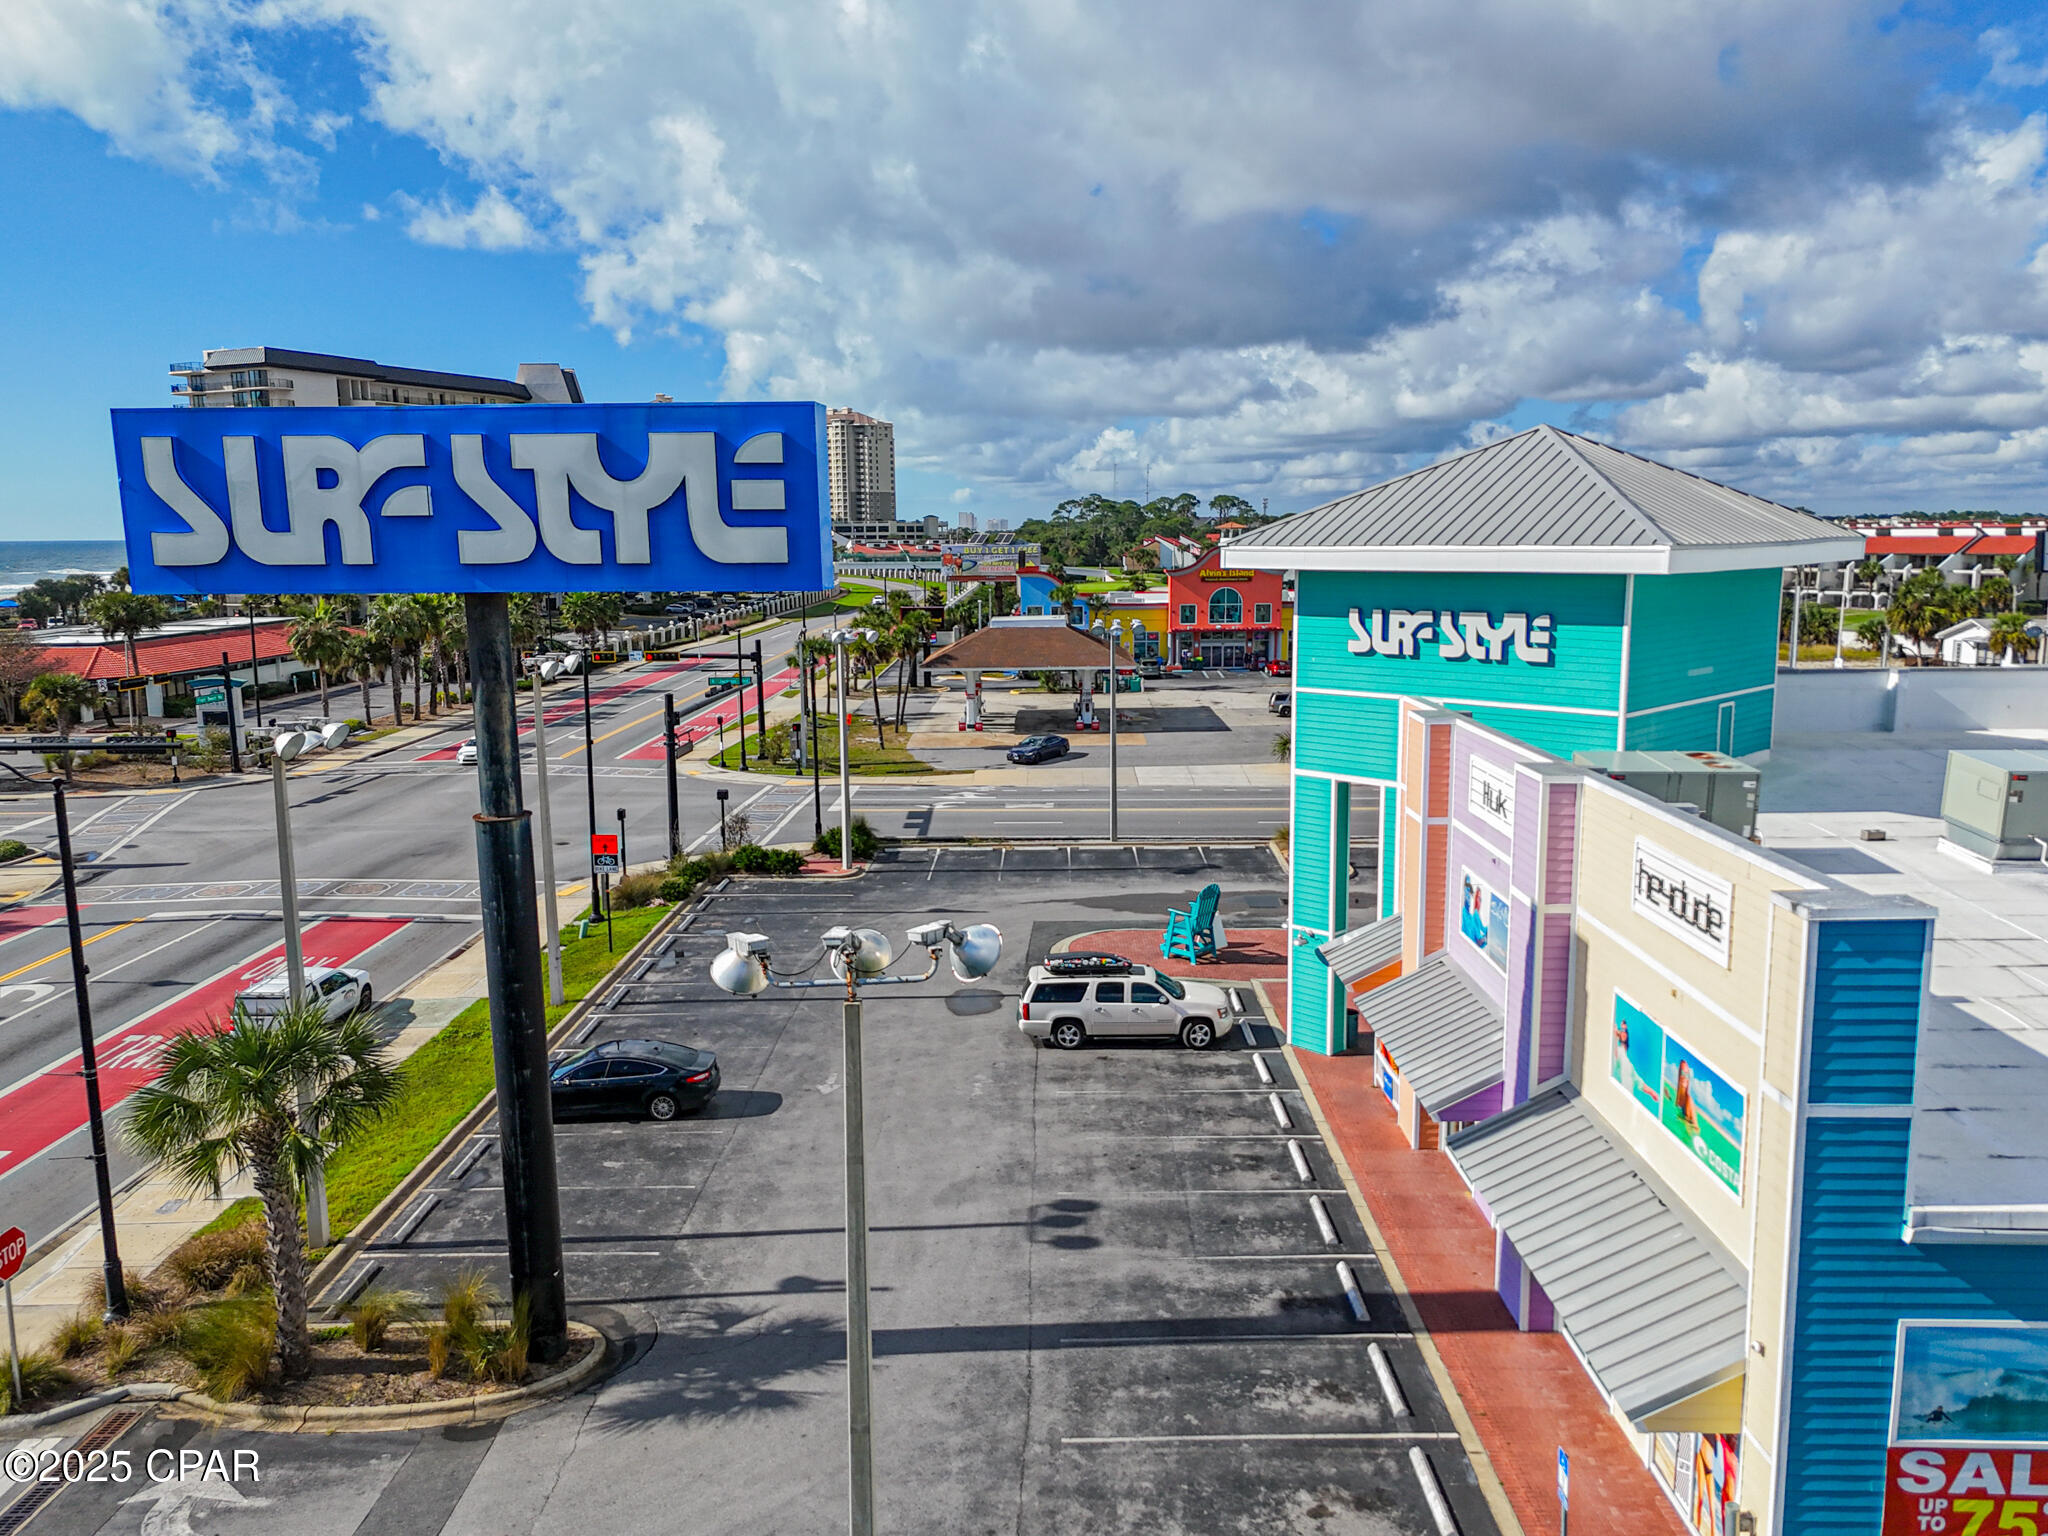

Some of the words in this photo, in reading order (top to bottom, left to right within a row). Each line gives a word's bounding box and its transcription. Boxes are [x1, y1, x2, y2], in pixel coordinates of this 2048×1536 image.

[140, 433, 433, 567] SURF
[450, 430, 788, 565] STYLE
[963, 546, 983, 554] BUY
[991, 546, 1009, 554] GET
[1199, 569, 1227, 577] Alvin's
[1229, 569, 1255, 577] Island
[1347, 607, 1434, 656] SURF
[1438, 610, 1551, 663] STYLE
[240, 956, 339, 981] ONY
[1918, 1497, 1949, 1514] UP
[1916, 1515, 1947, 1532] TO
[1951, 1499, 2048, 1536] 75
